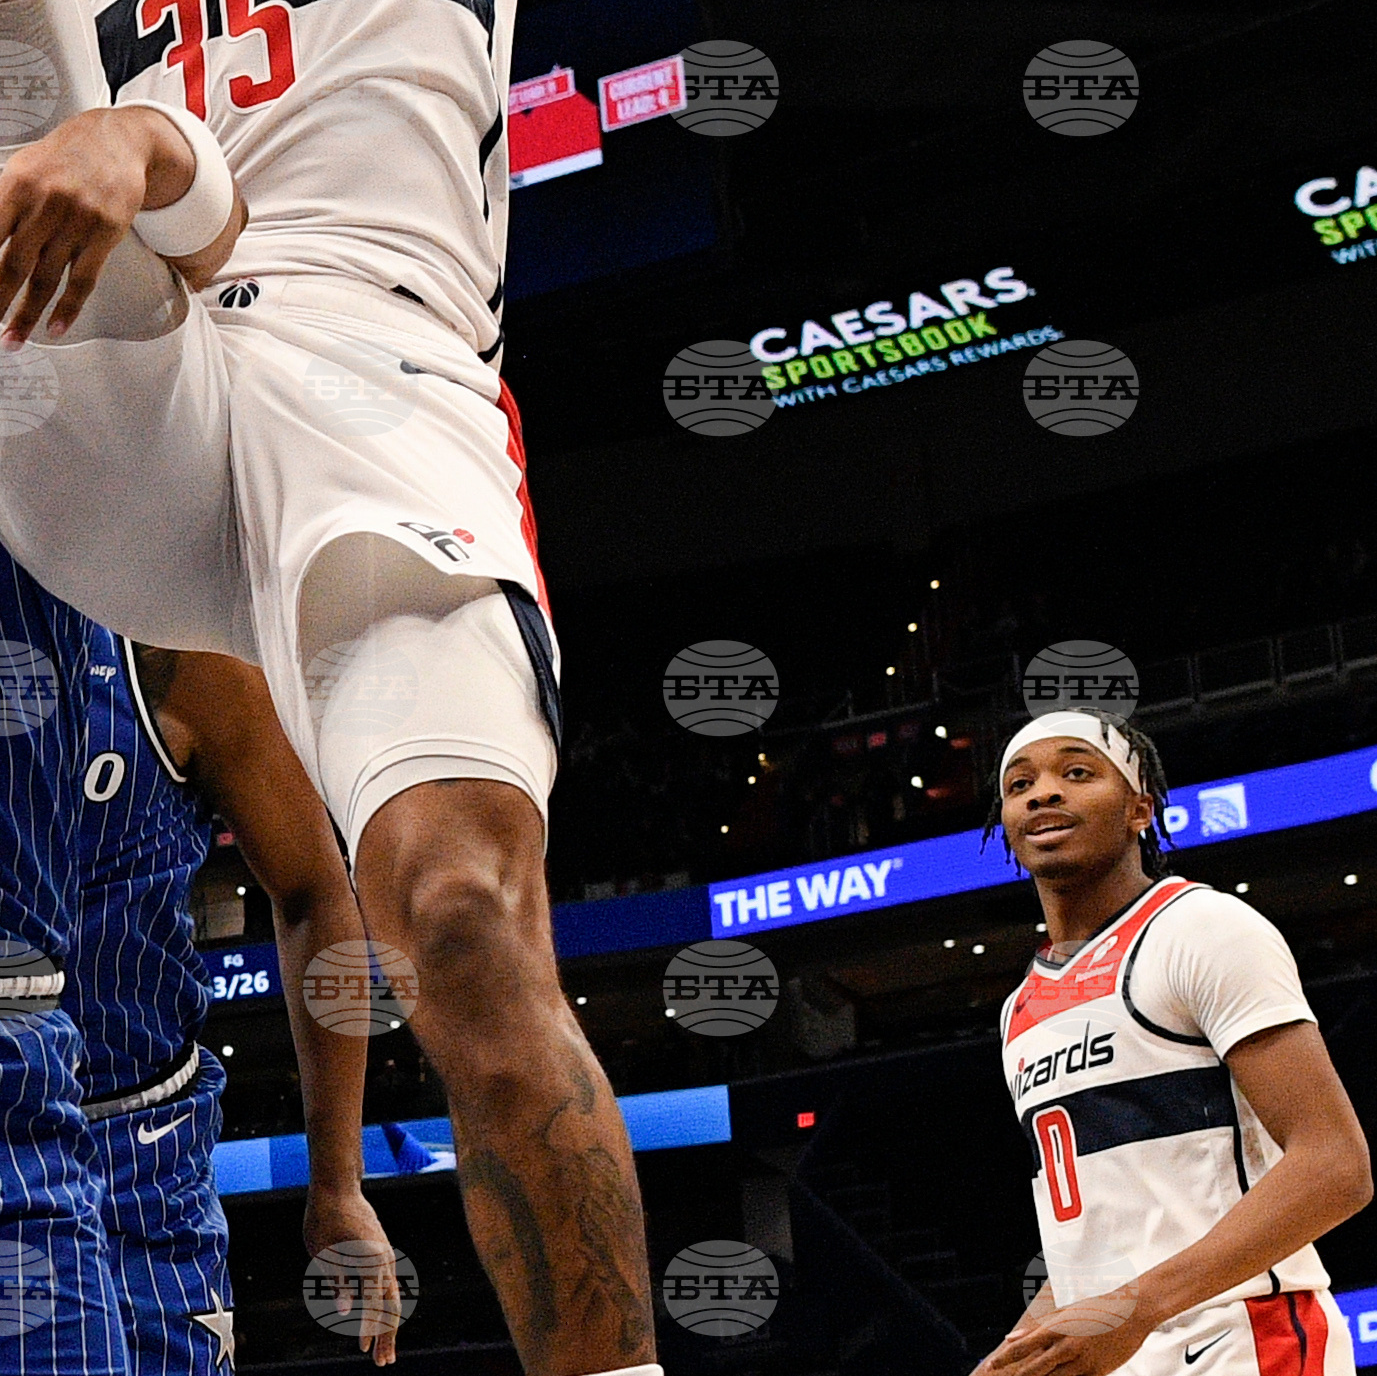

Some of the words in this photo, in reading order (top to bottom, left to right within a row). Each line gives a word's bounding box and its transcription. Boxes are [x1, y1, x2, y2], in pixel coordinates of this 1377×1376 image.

[761, 311, 998, 390] SPORTSBOOK
[771, 383, 837, 409] WITH
[841, 355, 949, 394] CAESARS
[713, 880, 792, 928] THE
[795, 858, 893, 911] WAY
[223, 953, 244, 969] FG
[1035, 1109, 1082, 1223] 0
